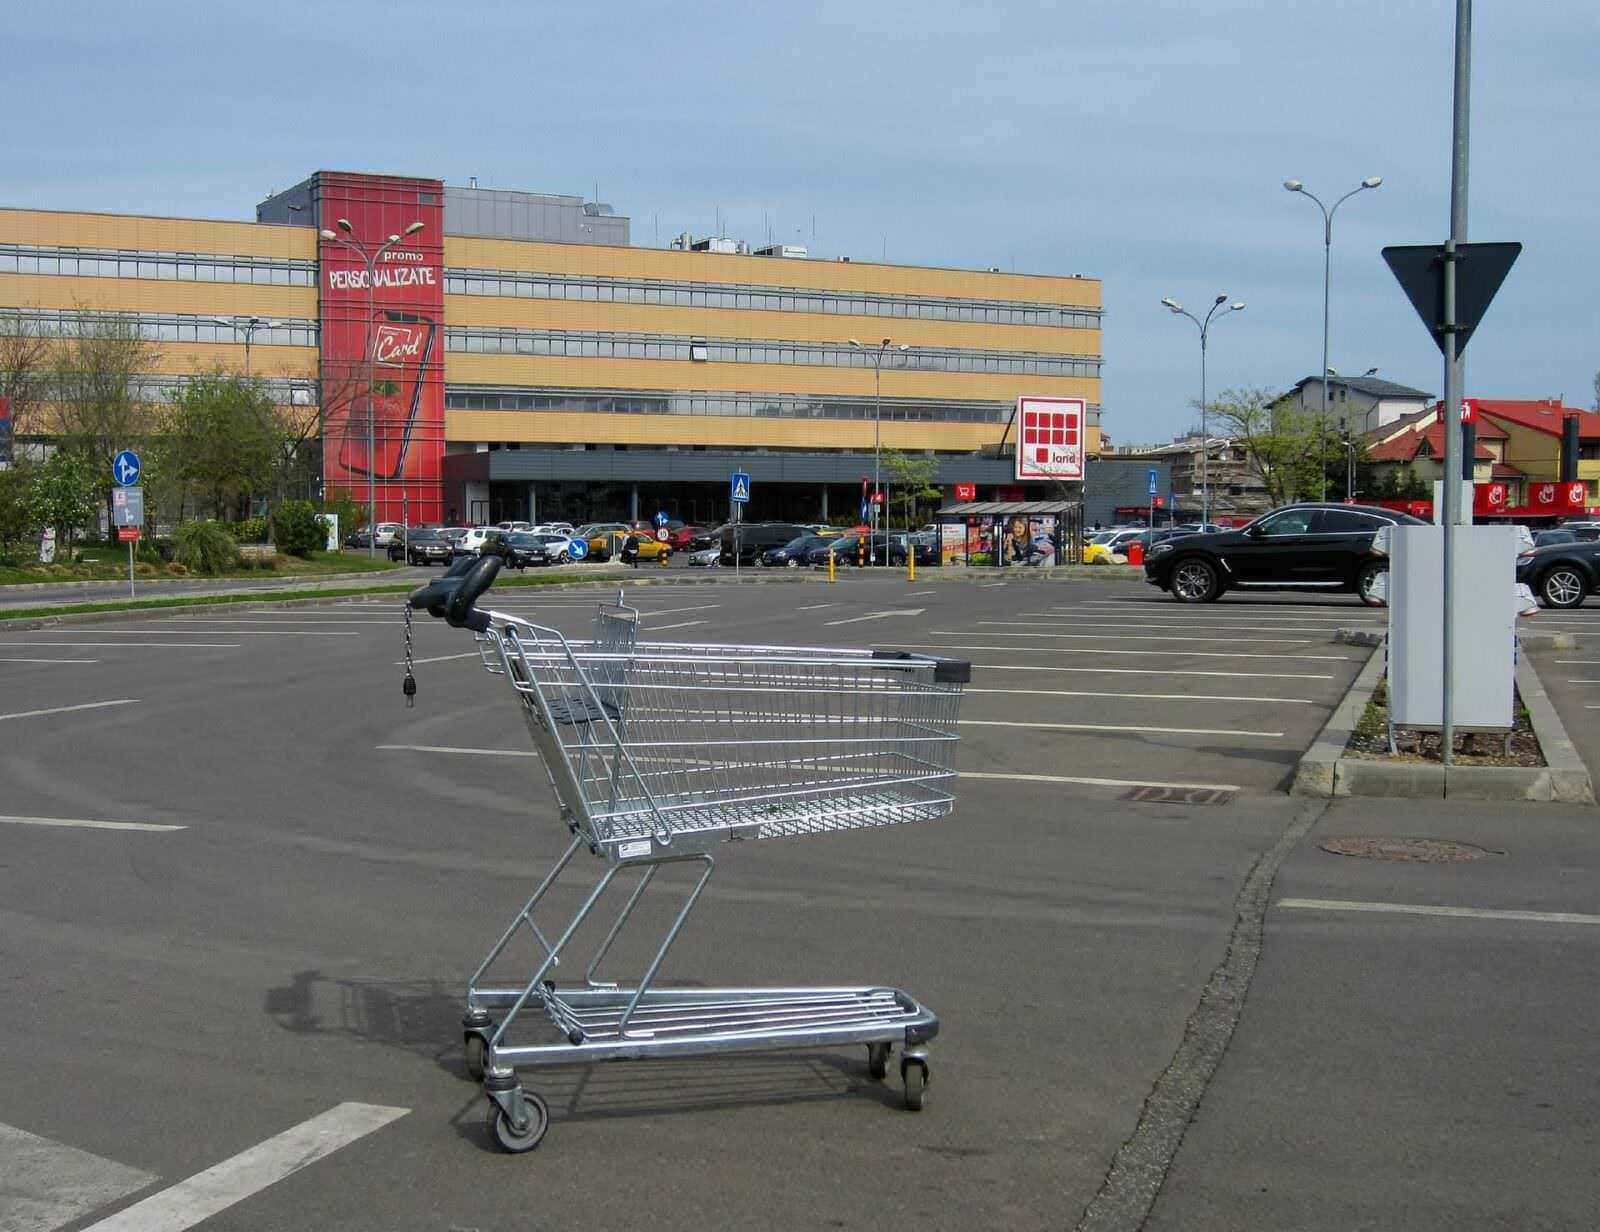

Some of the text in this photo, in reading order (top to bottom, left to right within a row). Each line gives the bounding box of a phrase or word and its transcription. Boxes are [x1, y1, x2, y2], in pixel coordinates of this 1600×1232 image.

[384, 251, 424, 262] promo
[329, 267, 436, 289] PERSONALIZATE
[378, 333, 421, 361] Card
[1052, 452, 1076, 464] land
